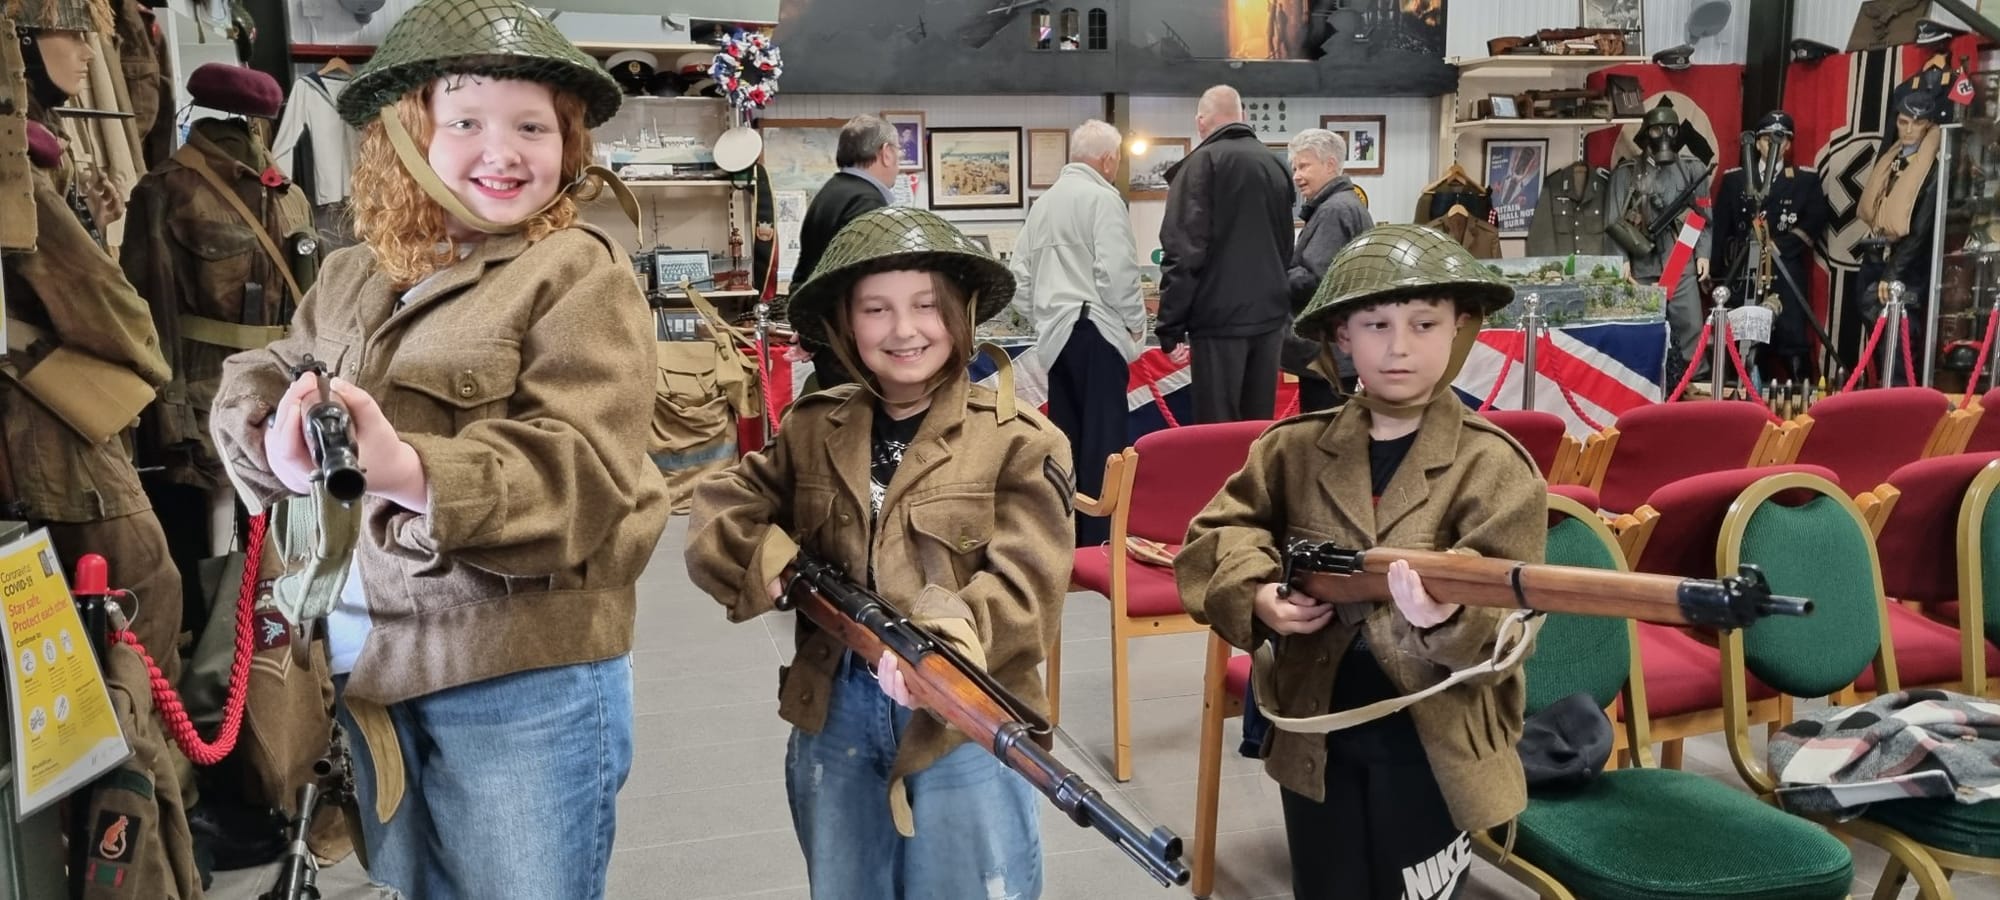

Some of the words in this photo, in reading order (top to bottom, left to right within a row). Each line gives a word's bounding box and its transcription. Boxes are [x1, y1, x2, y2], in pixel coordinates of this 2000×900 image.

[1520, 208, 1535, 218] NOT
[1503, 218, 1525, 228] BURN
[4, 575, 34, 597] COVID-19
[9, 602, 26, 618] Stay
[13, 613, 41, 634] Protect
[1402, 830, 1472, 900] NIKE
